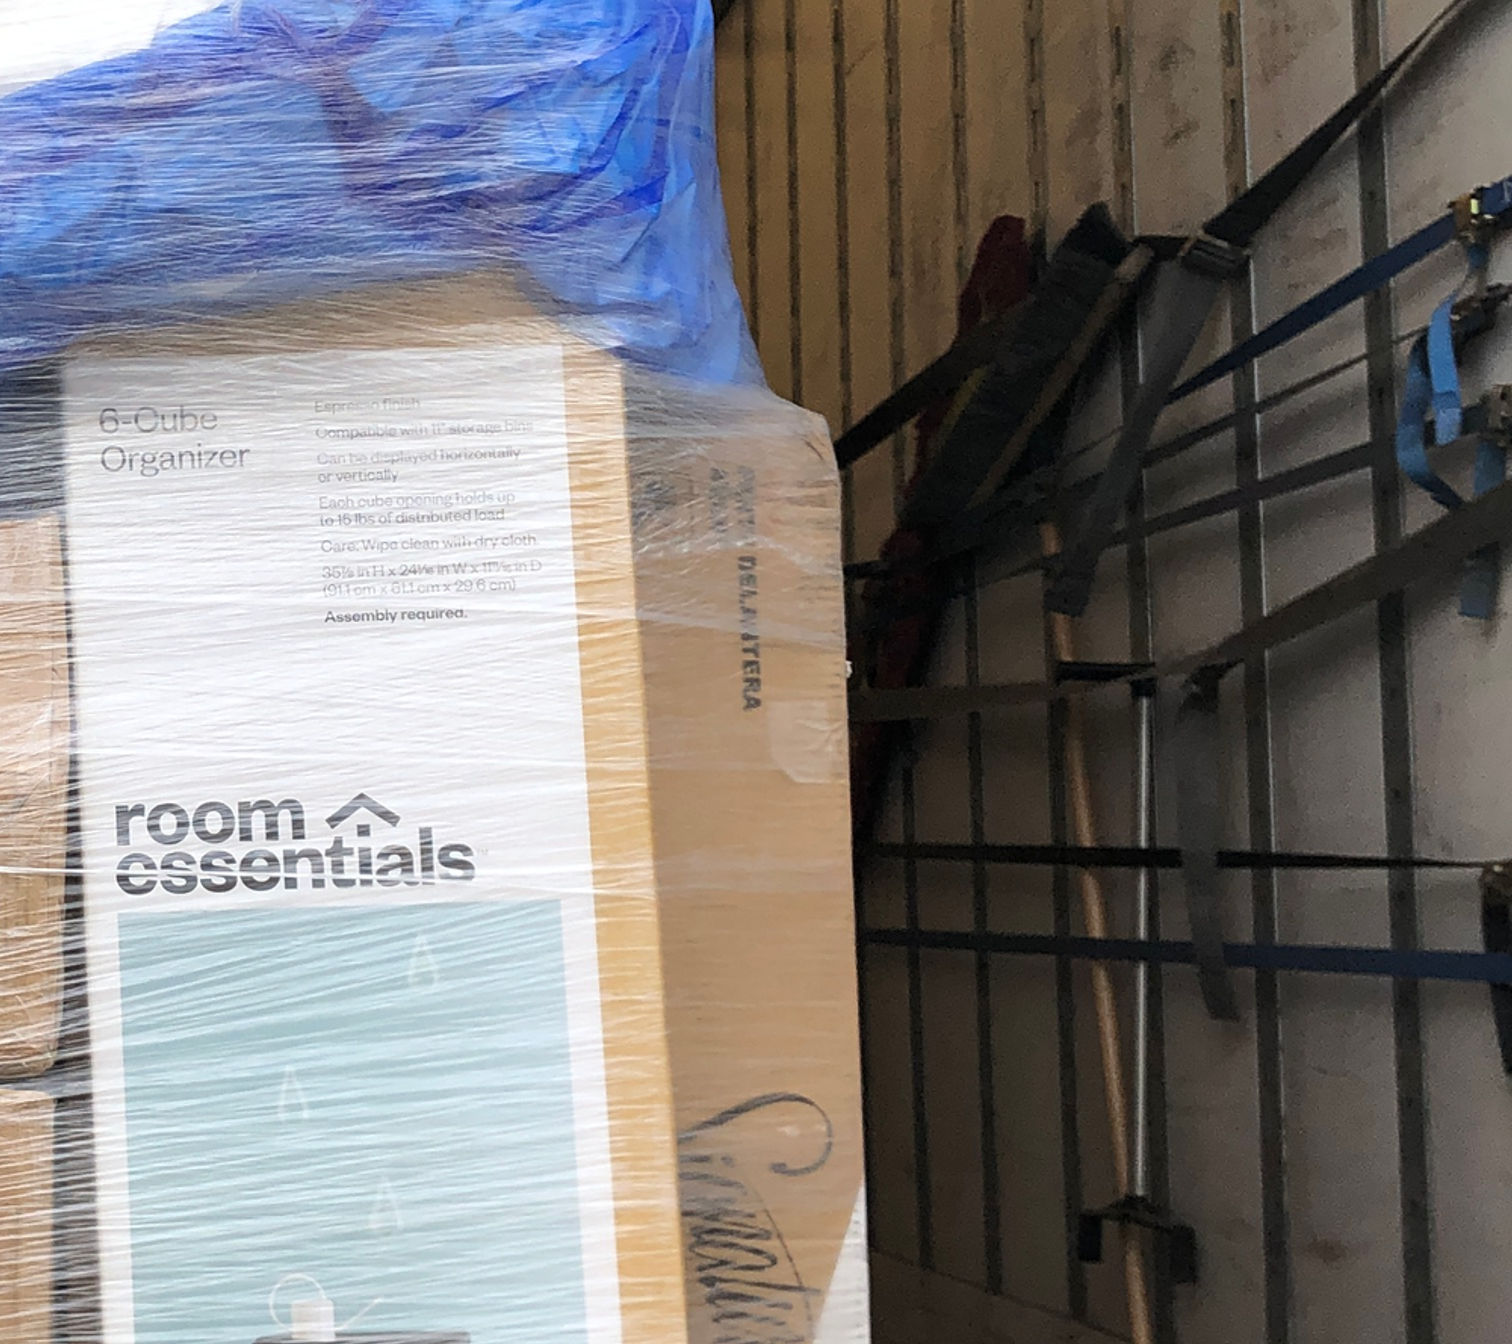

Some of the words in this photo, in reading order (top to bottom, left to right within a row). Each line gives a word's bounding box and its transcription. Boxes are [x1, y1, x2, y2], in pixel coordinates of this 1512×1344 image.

[99, 405, 218, 434] 6-Cube
[100, 442, 251, 478] Organizer
[317, 451, 346, 466] Can
[318, 472, 332, 483] or
[335, 467, 399, 484] vertically
[319, 495, 355, 510] Each
[358, 494, 393, 508] cube
[396, 492, 454, 507] opening
[456, 491, 494, 505] holds
[497, 491, 516, 506] up
[320, 515, 336, 527] to
[354, 512, 376, 526] lbs
[378, 511, 394, 525] of
[395, 508, 471, 525] distributed
[474, 507, 505, 522] load
[362, 539, 398, 554] Wipe
[401, 536, 439, 551] clean
[474, 534, 498, 550] dry
[372, 564, 386, 577] H
[387, 567, 397, 577] x
[452, 561, 468, 574] W
[470, 563, 479, 573] x
[530, 558, 543, 572] D
[353, 585, 377, 597] cm
[381, 586, 388, 595] x
[417, 582, 440, 594] cm
[442, 582, 451, 593] x
[488, 577, 517, 593] cm)
[324, 608, 398, 624] Assembly
[400, 606, 469, 622] required.
[114, 797, 306, 846] room
[115, 823, 477, 896] essentials
